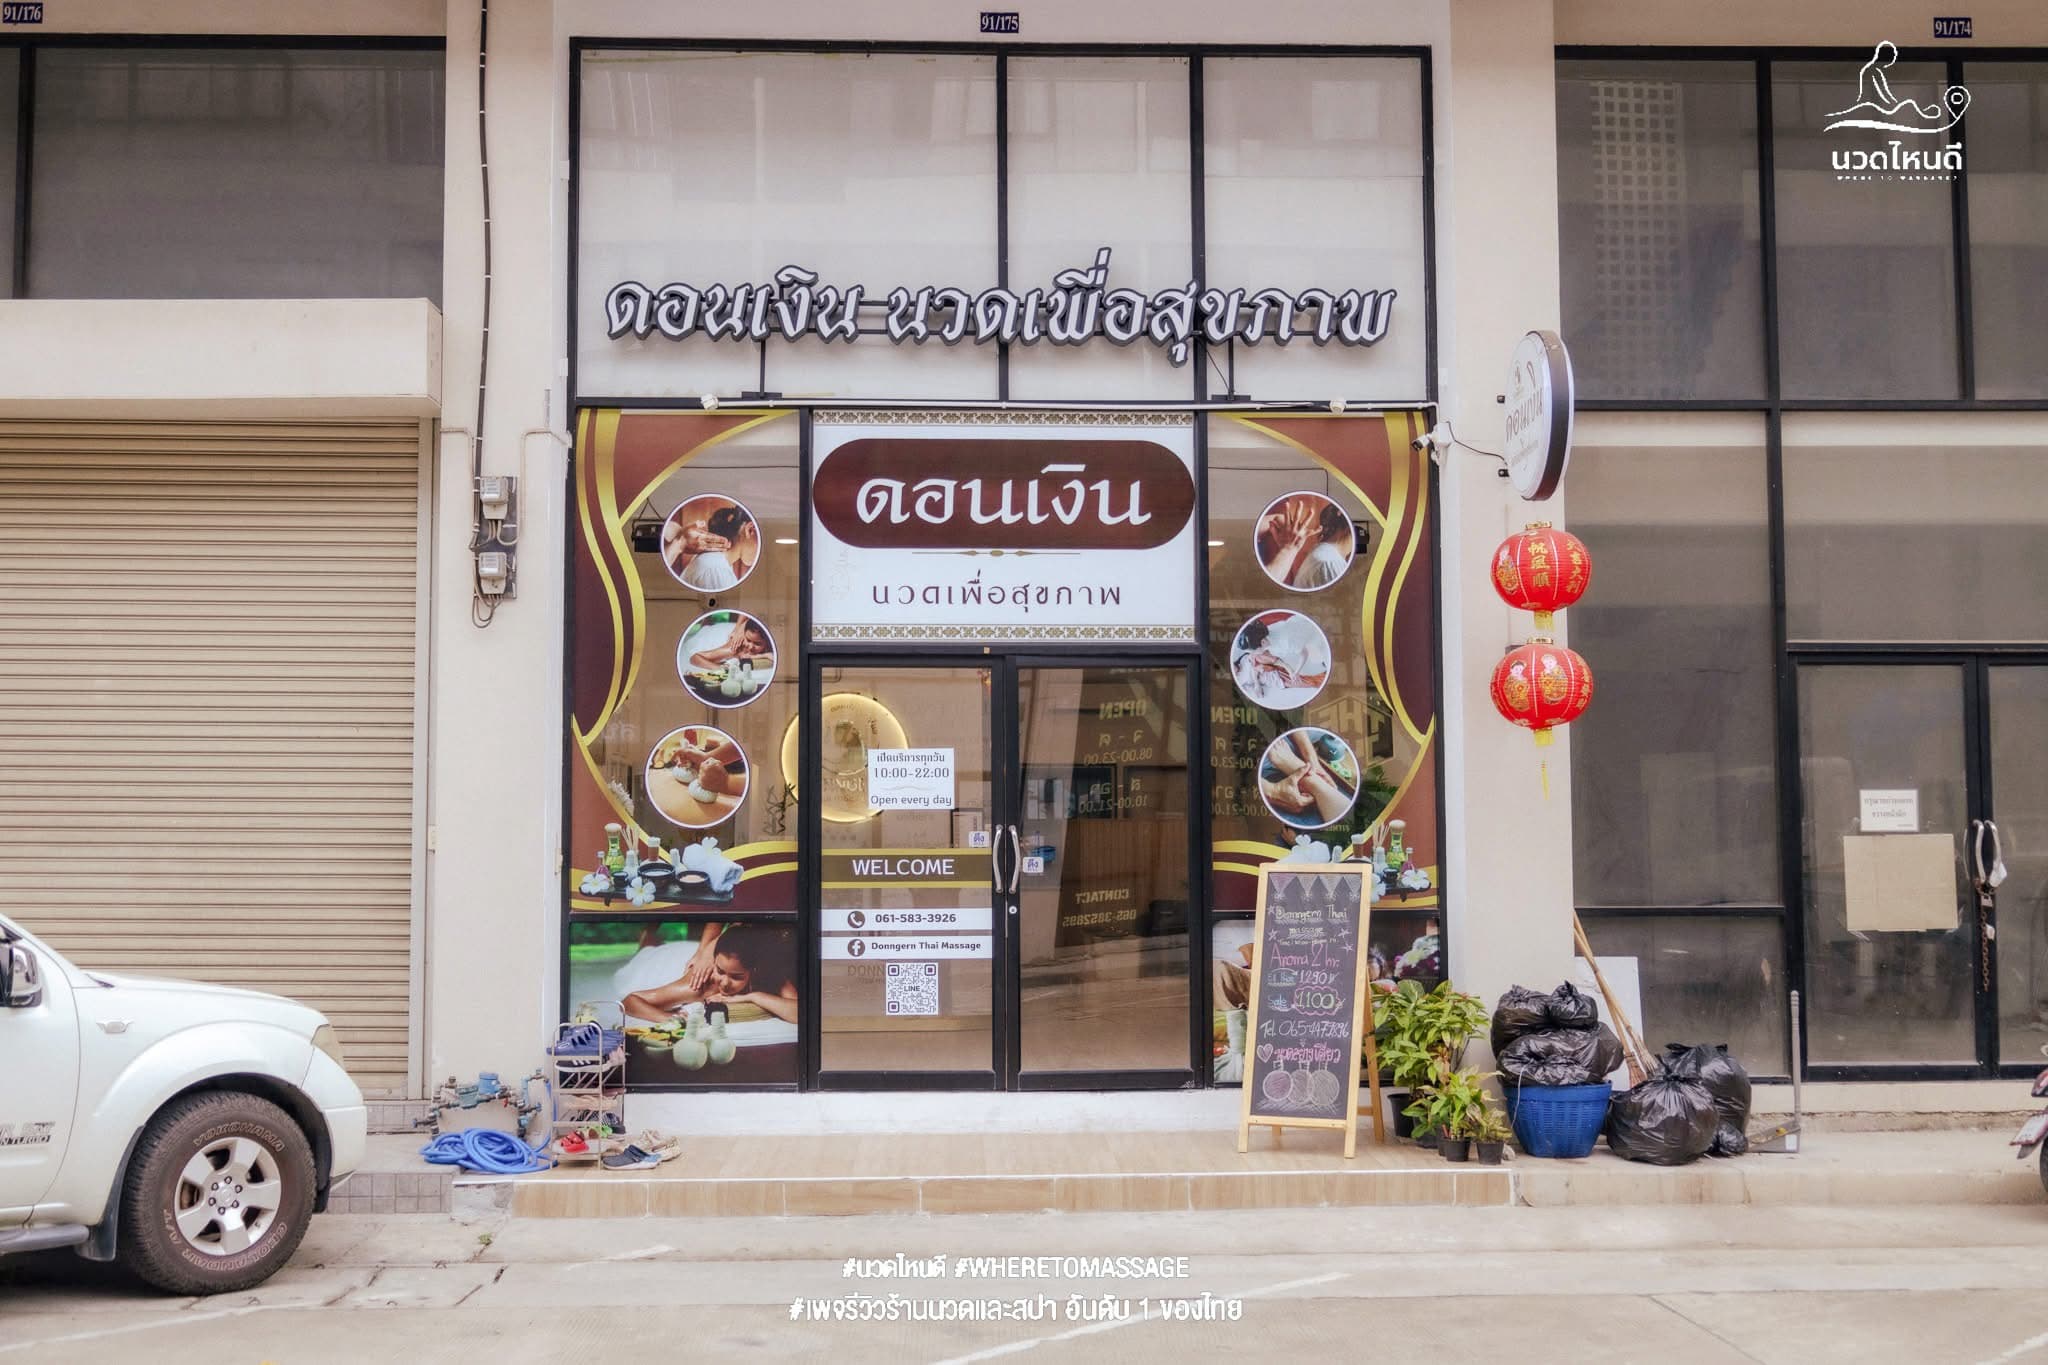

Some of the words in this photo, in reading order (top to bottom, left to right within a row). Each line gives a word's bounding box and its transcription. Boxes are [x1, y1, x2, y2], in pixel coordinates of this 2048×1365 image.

[4, 6, 41, 20] 91/176
[981, 15, 1018, 31] 91/175
[1935, 20, 1972, 36] 91/174
[605, 264, 864, 343] ดอนเงิน
[886, 246, 1398, 367] นวดเพื่อสุขภาพ
[855, 463, 1151, 527] ดอนเงิน
[872, 569, 1122, 614] นวดเพื่อสุขภาพ
[877, 752, 945, 766] เปิดบริการทุกวัน
[874, 767, 950, 778] 10:00-22:00
[870, 795, 898, 807] Open
[901, 796, 930, 807] every
[933, 795, 952, 807] day
[852, 859, 955, 876] WELCOME
[875, 913, 957, 923] 061-583-3926
[871, 942, 916, 951] Donngern
[919, 942, 939, 950] Thai
[941, 942, 981, 951] Massage
[193, 1121, 286, 1152] YOKOHAMA
